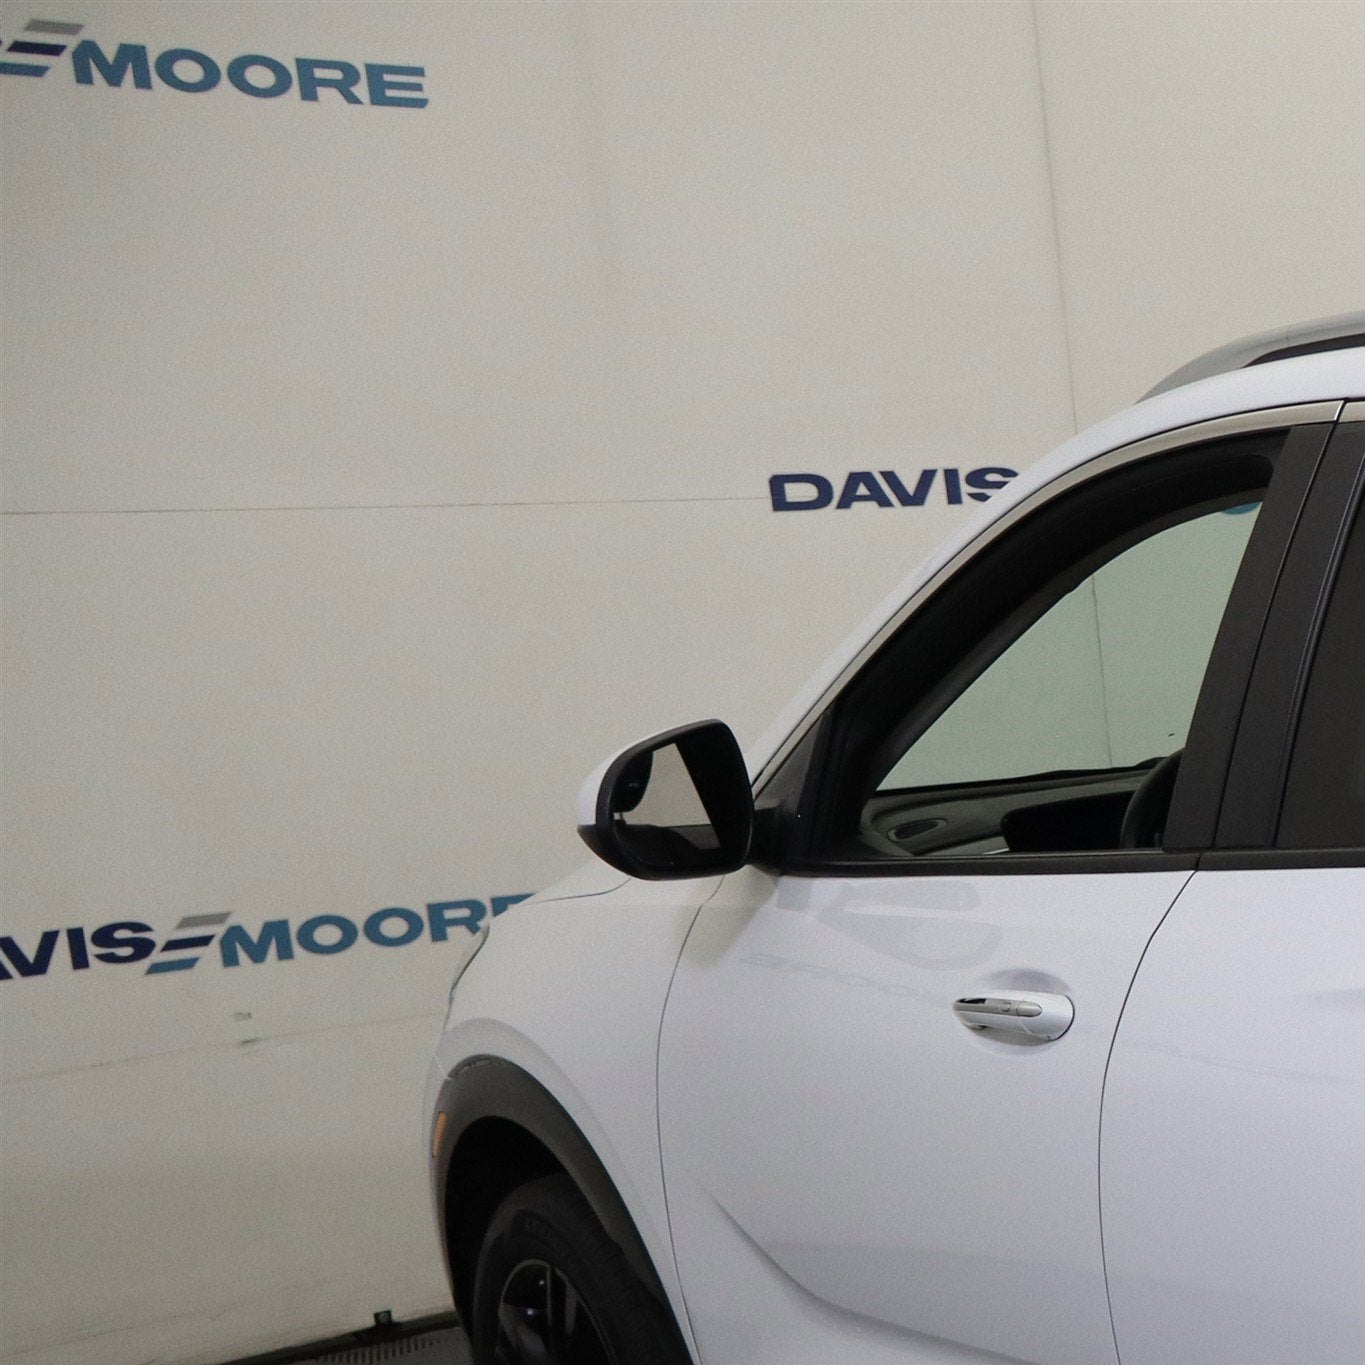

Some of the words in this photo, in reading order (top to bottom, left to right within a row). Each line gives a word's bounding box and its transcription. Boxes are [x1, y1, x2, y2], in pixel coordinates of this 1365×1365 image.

[71, 38, 430, 109] MOORE
[768, 466, 1020, 512] DAVIS
[0, 921, 156, 981] VIS
